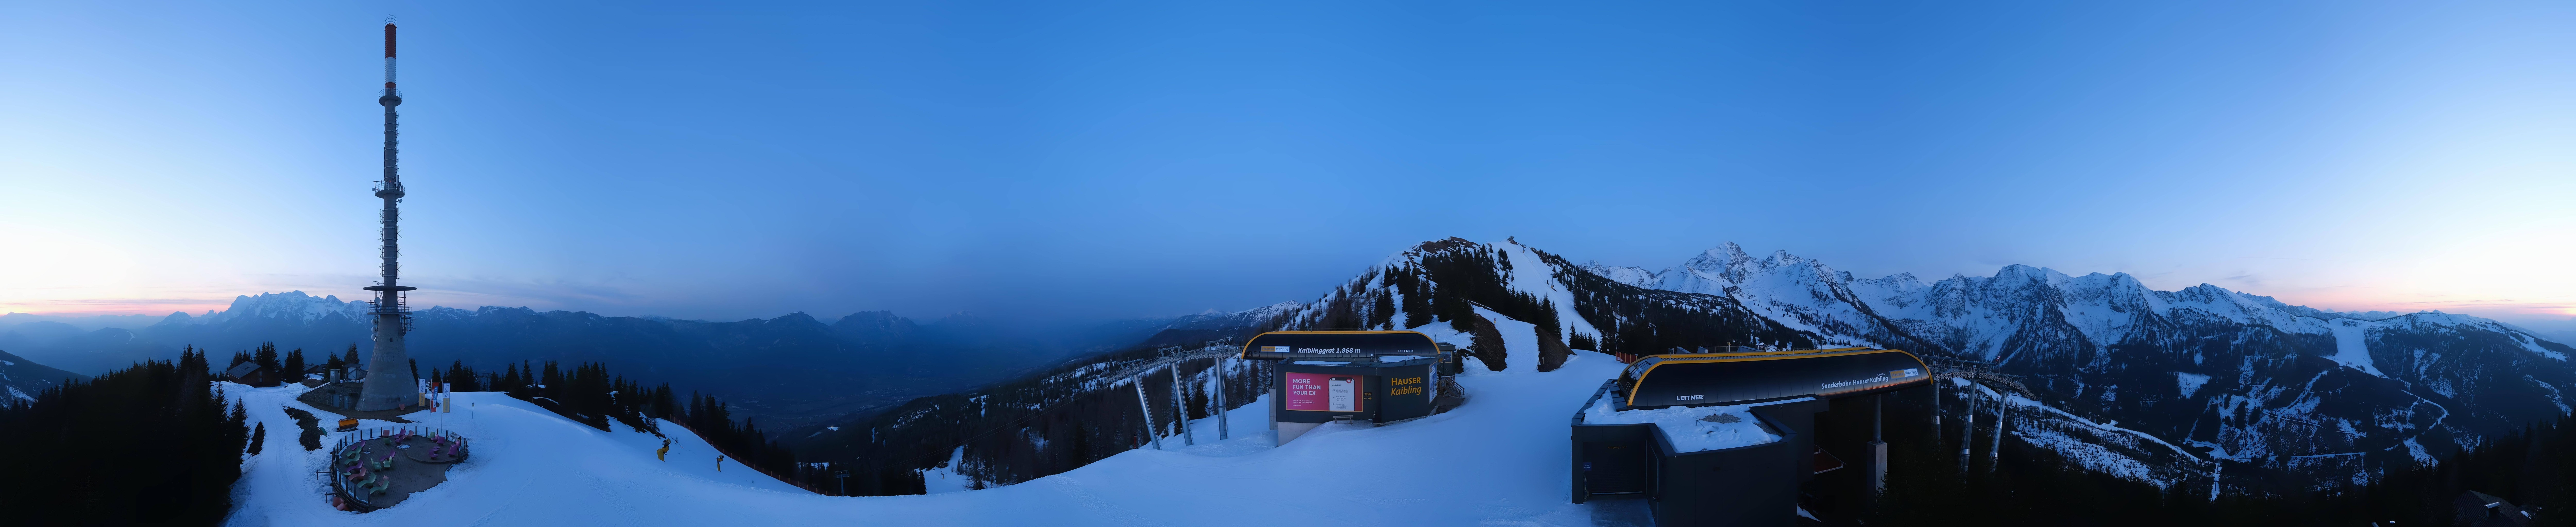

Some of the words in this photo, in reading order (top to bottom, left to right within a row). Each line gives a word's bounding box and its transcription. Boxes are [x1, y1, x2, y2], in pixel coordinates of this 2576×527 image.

[1392, 377, 1421, 386] HAUSER
[1821, 380, 1852, 389] Senderbahn
[1391, 386, 1421, 396] Kaibling
